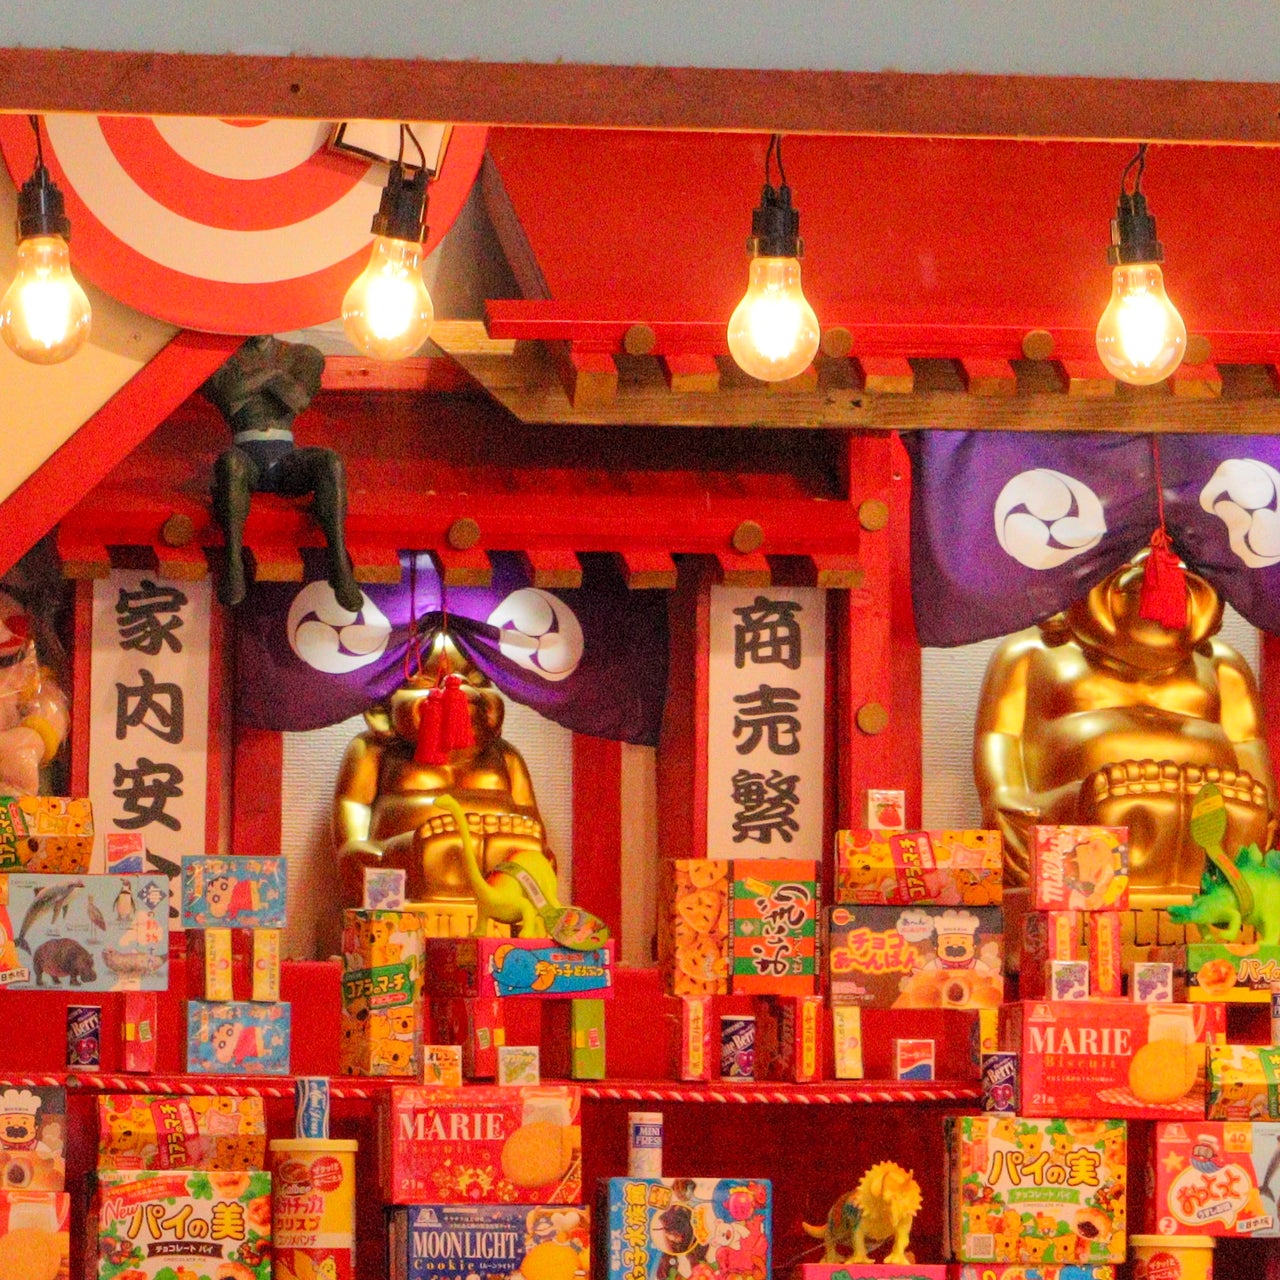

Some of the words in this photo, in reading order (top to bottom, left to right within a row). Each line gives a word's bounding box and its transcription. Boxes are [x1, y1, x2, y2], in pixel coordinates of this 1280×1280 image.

[753, 884, 811, 977] おにぎり
[850, 930, 906, 949] チョコ
[1029, 1027, 1132, 1055] MARIE
[398, 1114, 504, 1141] MARIE
[989, 1147, 1100, 1187] パイの実
[1177, 1170, 1240, 1215] おっとっと
[414, 1260, 474, 1270] Cookie
